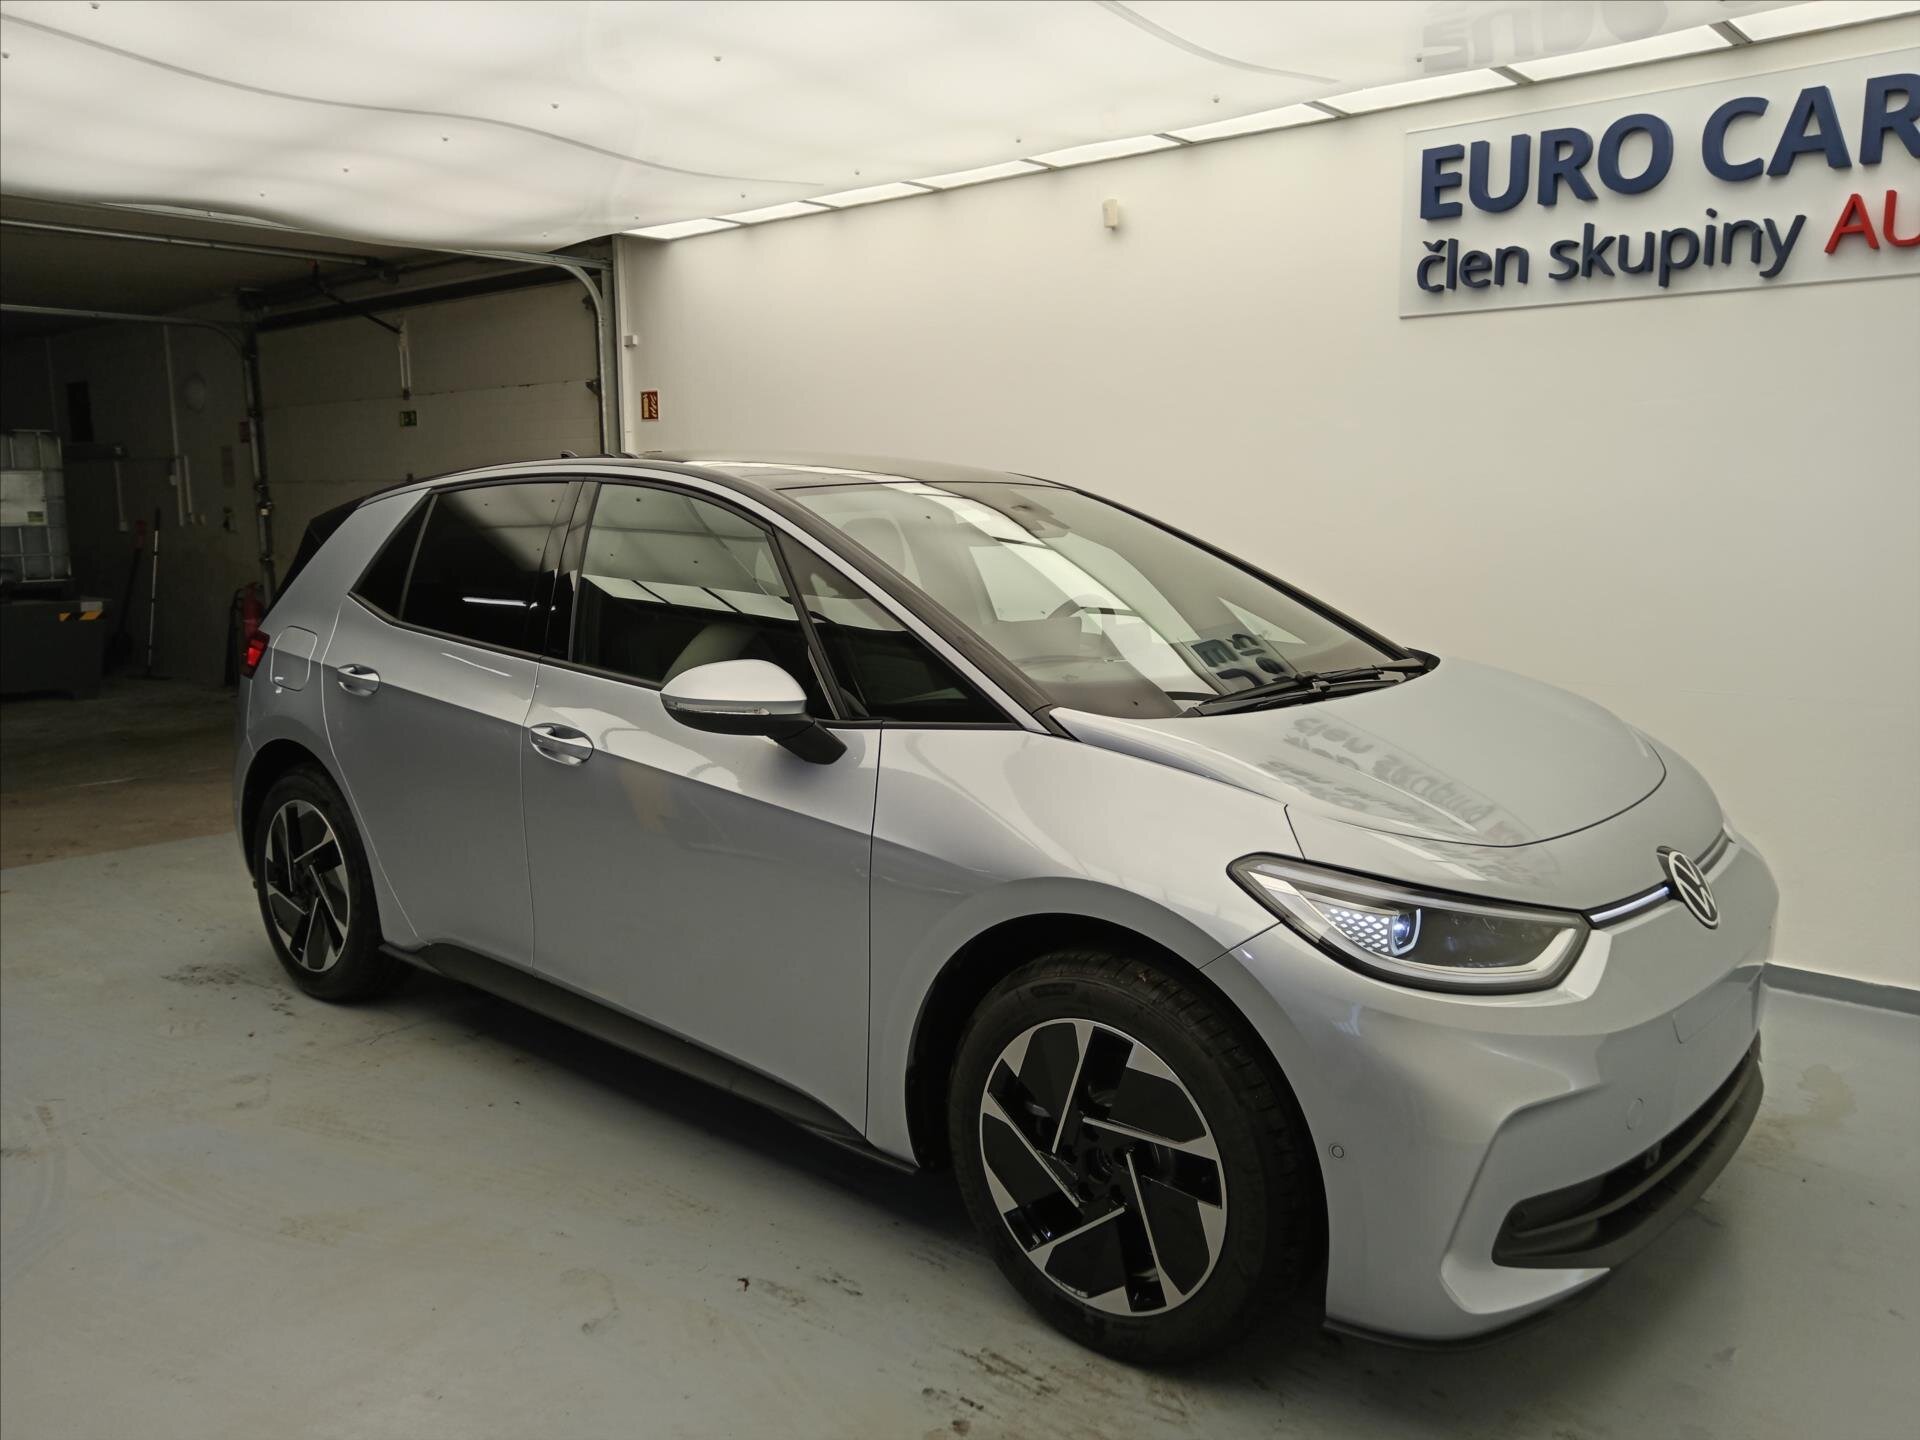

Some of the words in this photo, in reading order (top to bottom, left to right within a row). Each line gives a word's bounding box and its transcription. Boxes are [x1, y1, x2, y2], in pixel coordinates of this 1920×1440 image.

[1420, 113, 1674, 220] EURO
[1702, 73, 1920, 182] CAR
[1417, 238, 1530, 292] člen
[1548, 208, 1807, 288] skupiny
